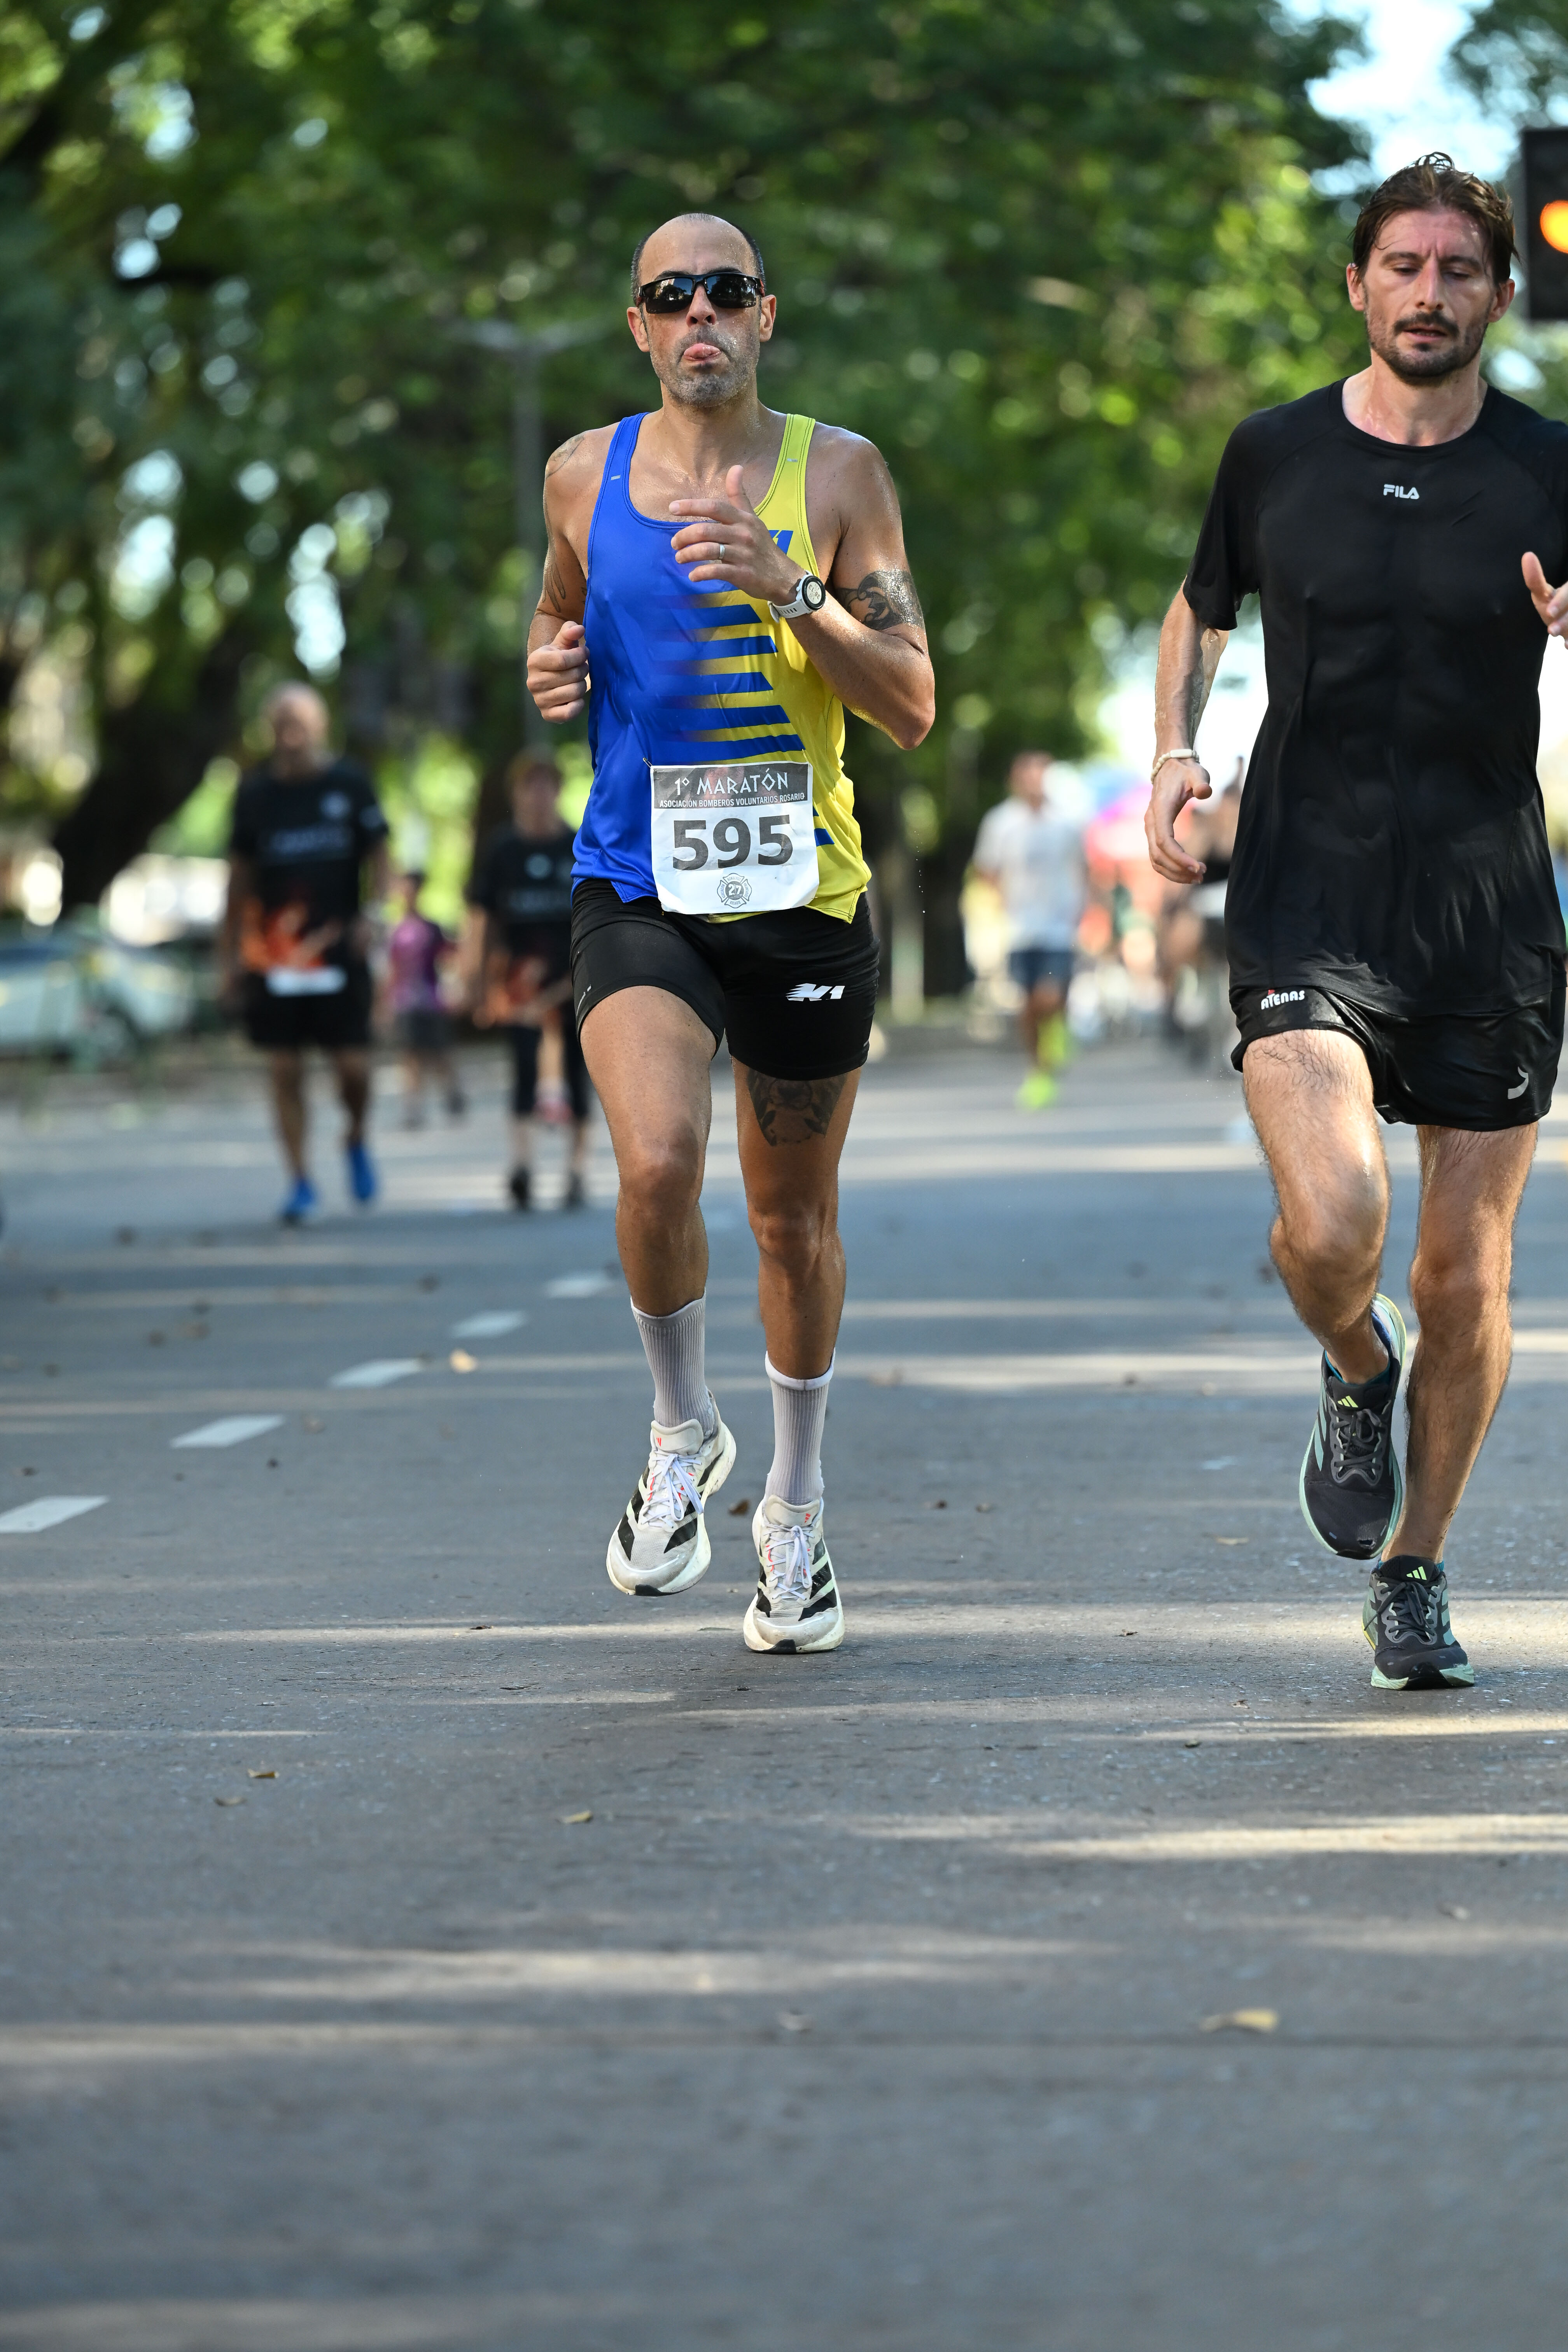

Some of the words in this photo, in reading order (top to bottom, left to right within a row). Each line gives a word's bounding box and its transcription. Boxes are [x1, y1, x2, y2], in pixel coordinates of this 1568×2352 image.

[1383, 484, 1419, 499] FILA
[808, 584, 821, 600] 38:13
[696, 768, 788, 795] MARATÓN
[660, 798, 697, 808] ASOCIACIÓN
[699, 799, 734, 807] BOMBEROS
[736, 795, 778, 806] VOLUNTARIOS
[779, 792, 805, 802] ROSARIO
[673, 815, 793, 870] 595
[728, 884, 742, 896] 27
[1261, 990, 1305, 1010] ATENAS
